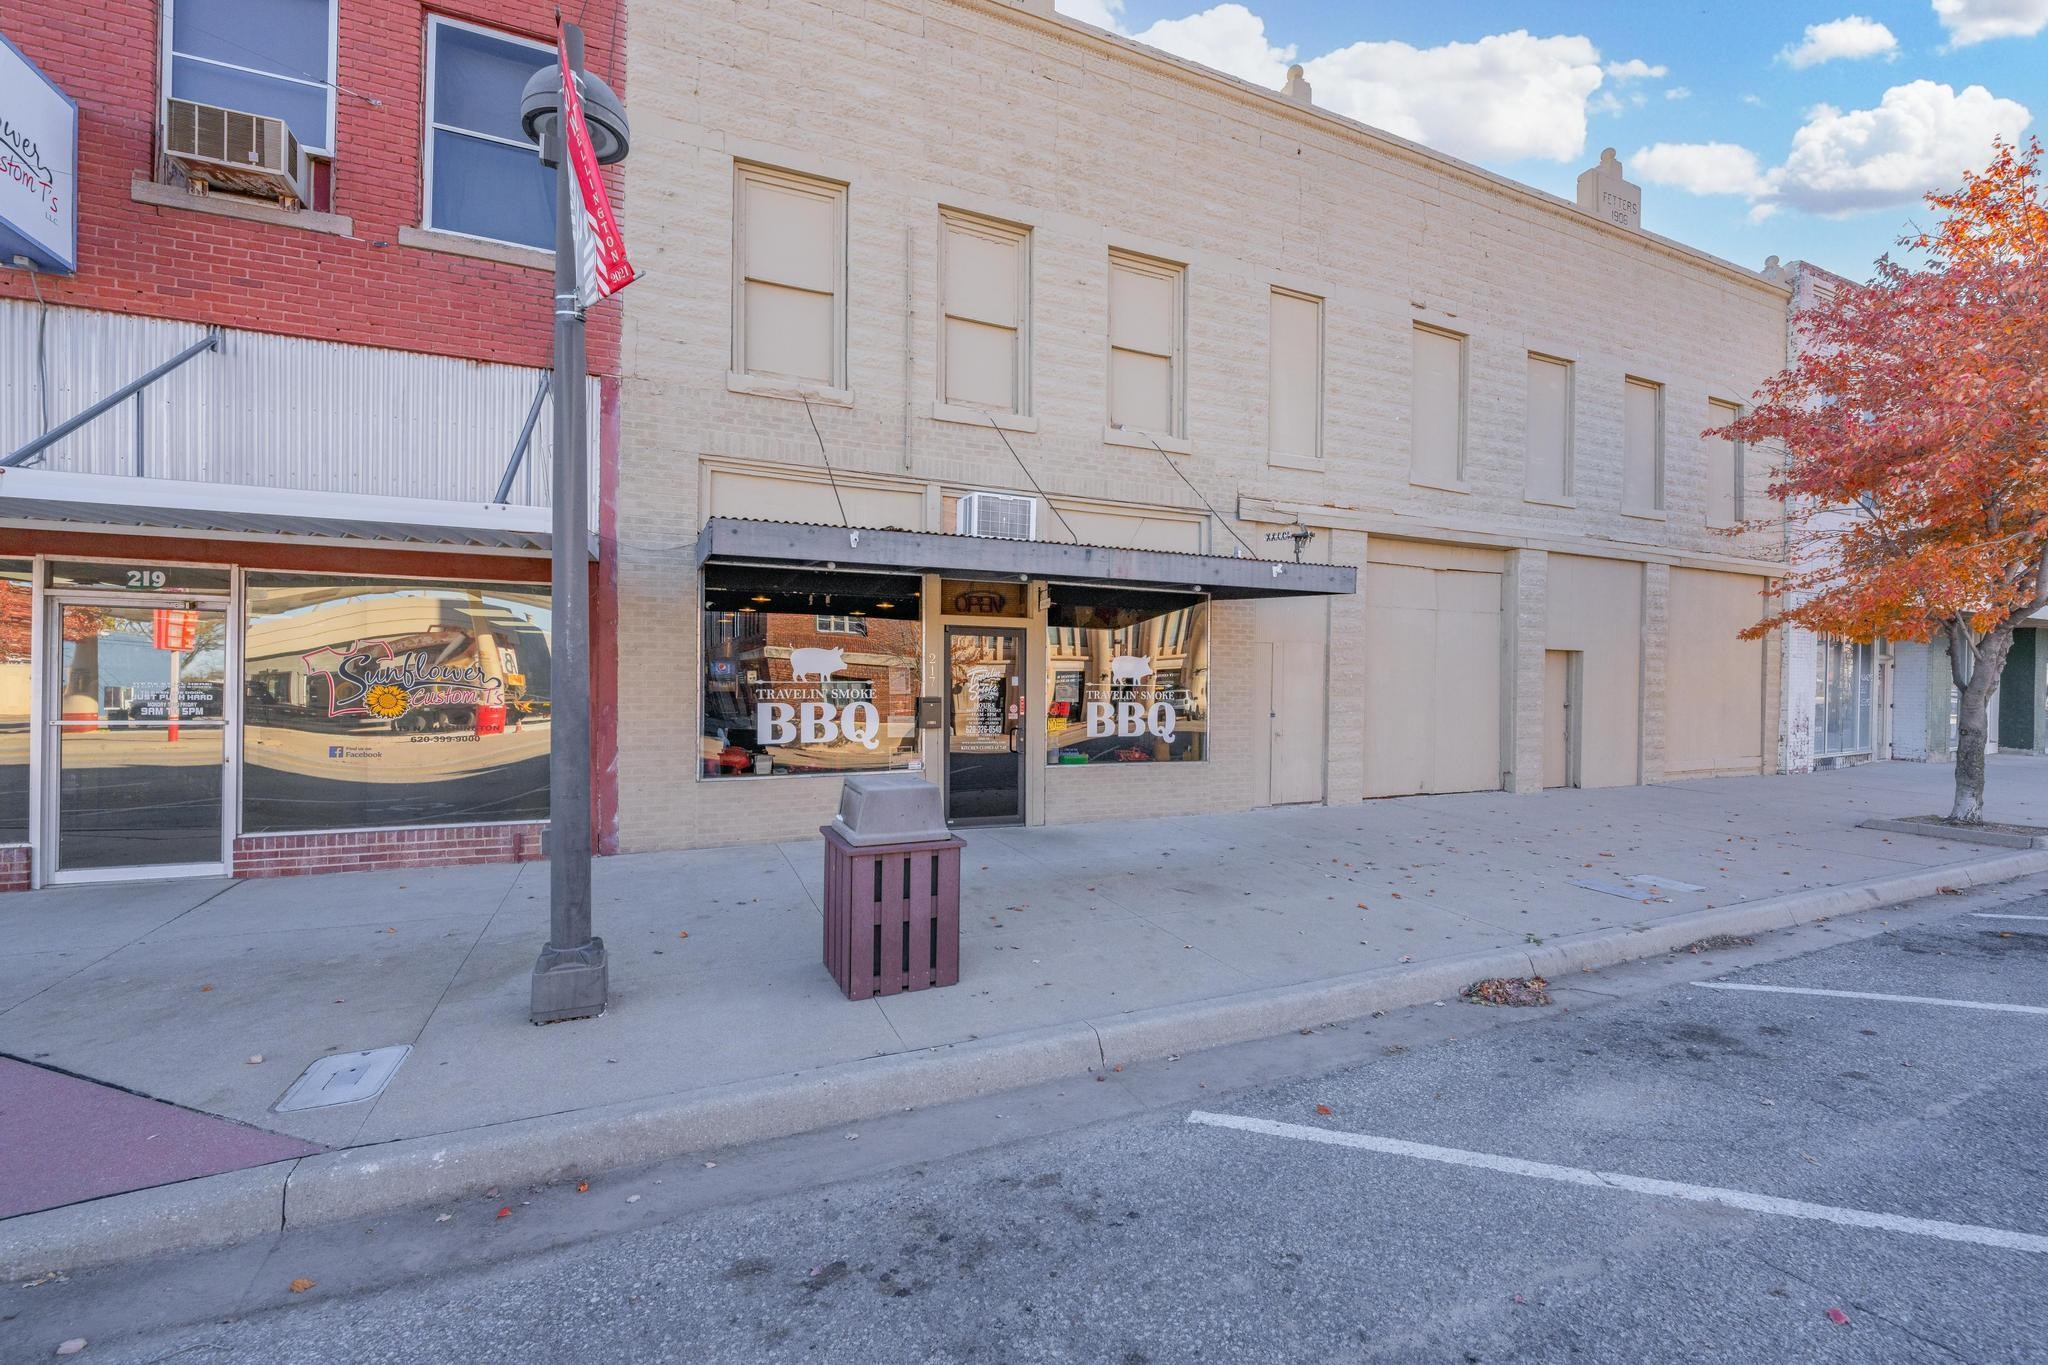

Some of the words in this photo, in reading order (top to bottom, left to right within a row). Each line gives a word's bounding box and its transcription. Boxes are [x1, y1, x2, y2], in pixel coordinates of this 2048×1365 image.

[1603, 191, 1638, 215] FETTERS
[610, 267, 630, 284] 2021
[126, 570, 166, 588] 219
[955, 594, 1006, 614] OPEN
[336, 652, 502, 706] Sunflower
[410, 686, 478, 706] Custom
[755, 687, 828, 700] TRAVELIN'
[831, 688, 877, 699] SMOKE
[1086, 690, 1139, 701] TRAVELIN'
[1140, 690, 1175, 701] SMOKE
[141, 707, 163, 715] 9AM
[182, 707, 204, 715] 5PM
[756, 701, 880, 750] BBQ
[1086, 701, 1176, 744] BBQ
